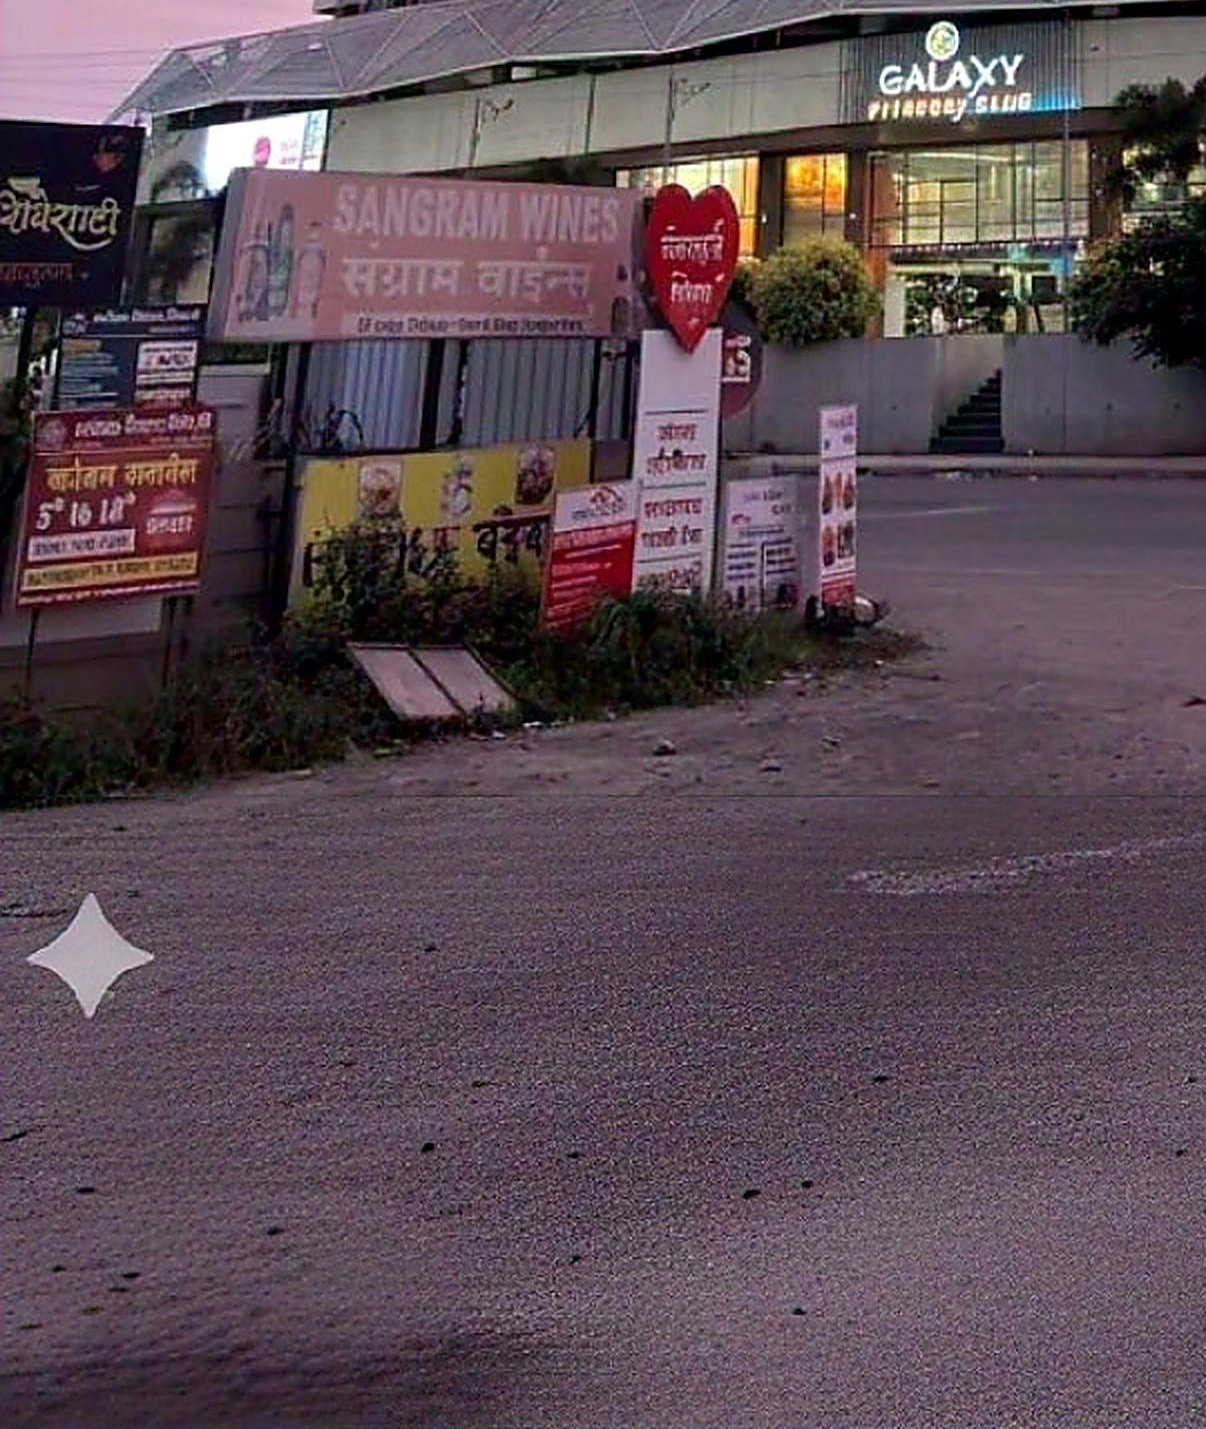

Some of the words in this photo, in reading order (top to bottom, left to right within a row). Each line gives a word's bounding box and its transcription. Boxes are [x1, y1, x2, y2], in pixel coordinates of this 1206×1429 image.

[879, 54, 1024, 98] GALAXY
[333, 185, 509, 240] SANGRAM
[520, 192, 619, 242] WINES
